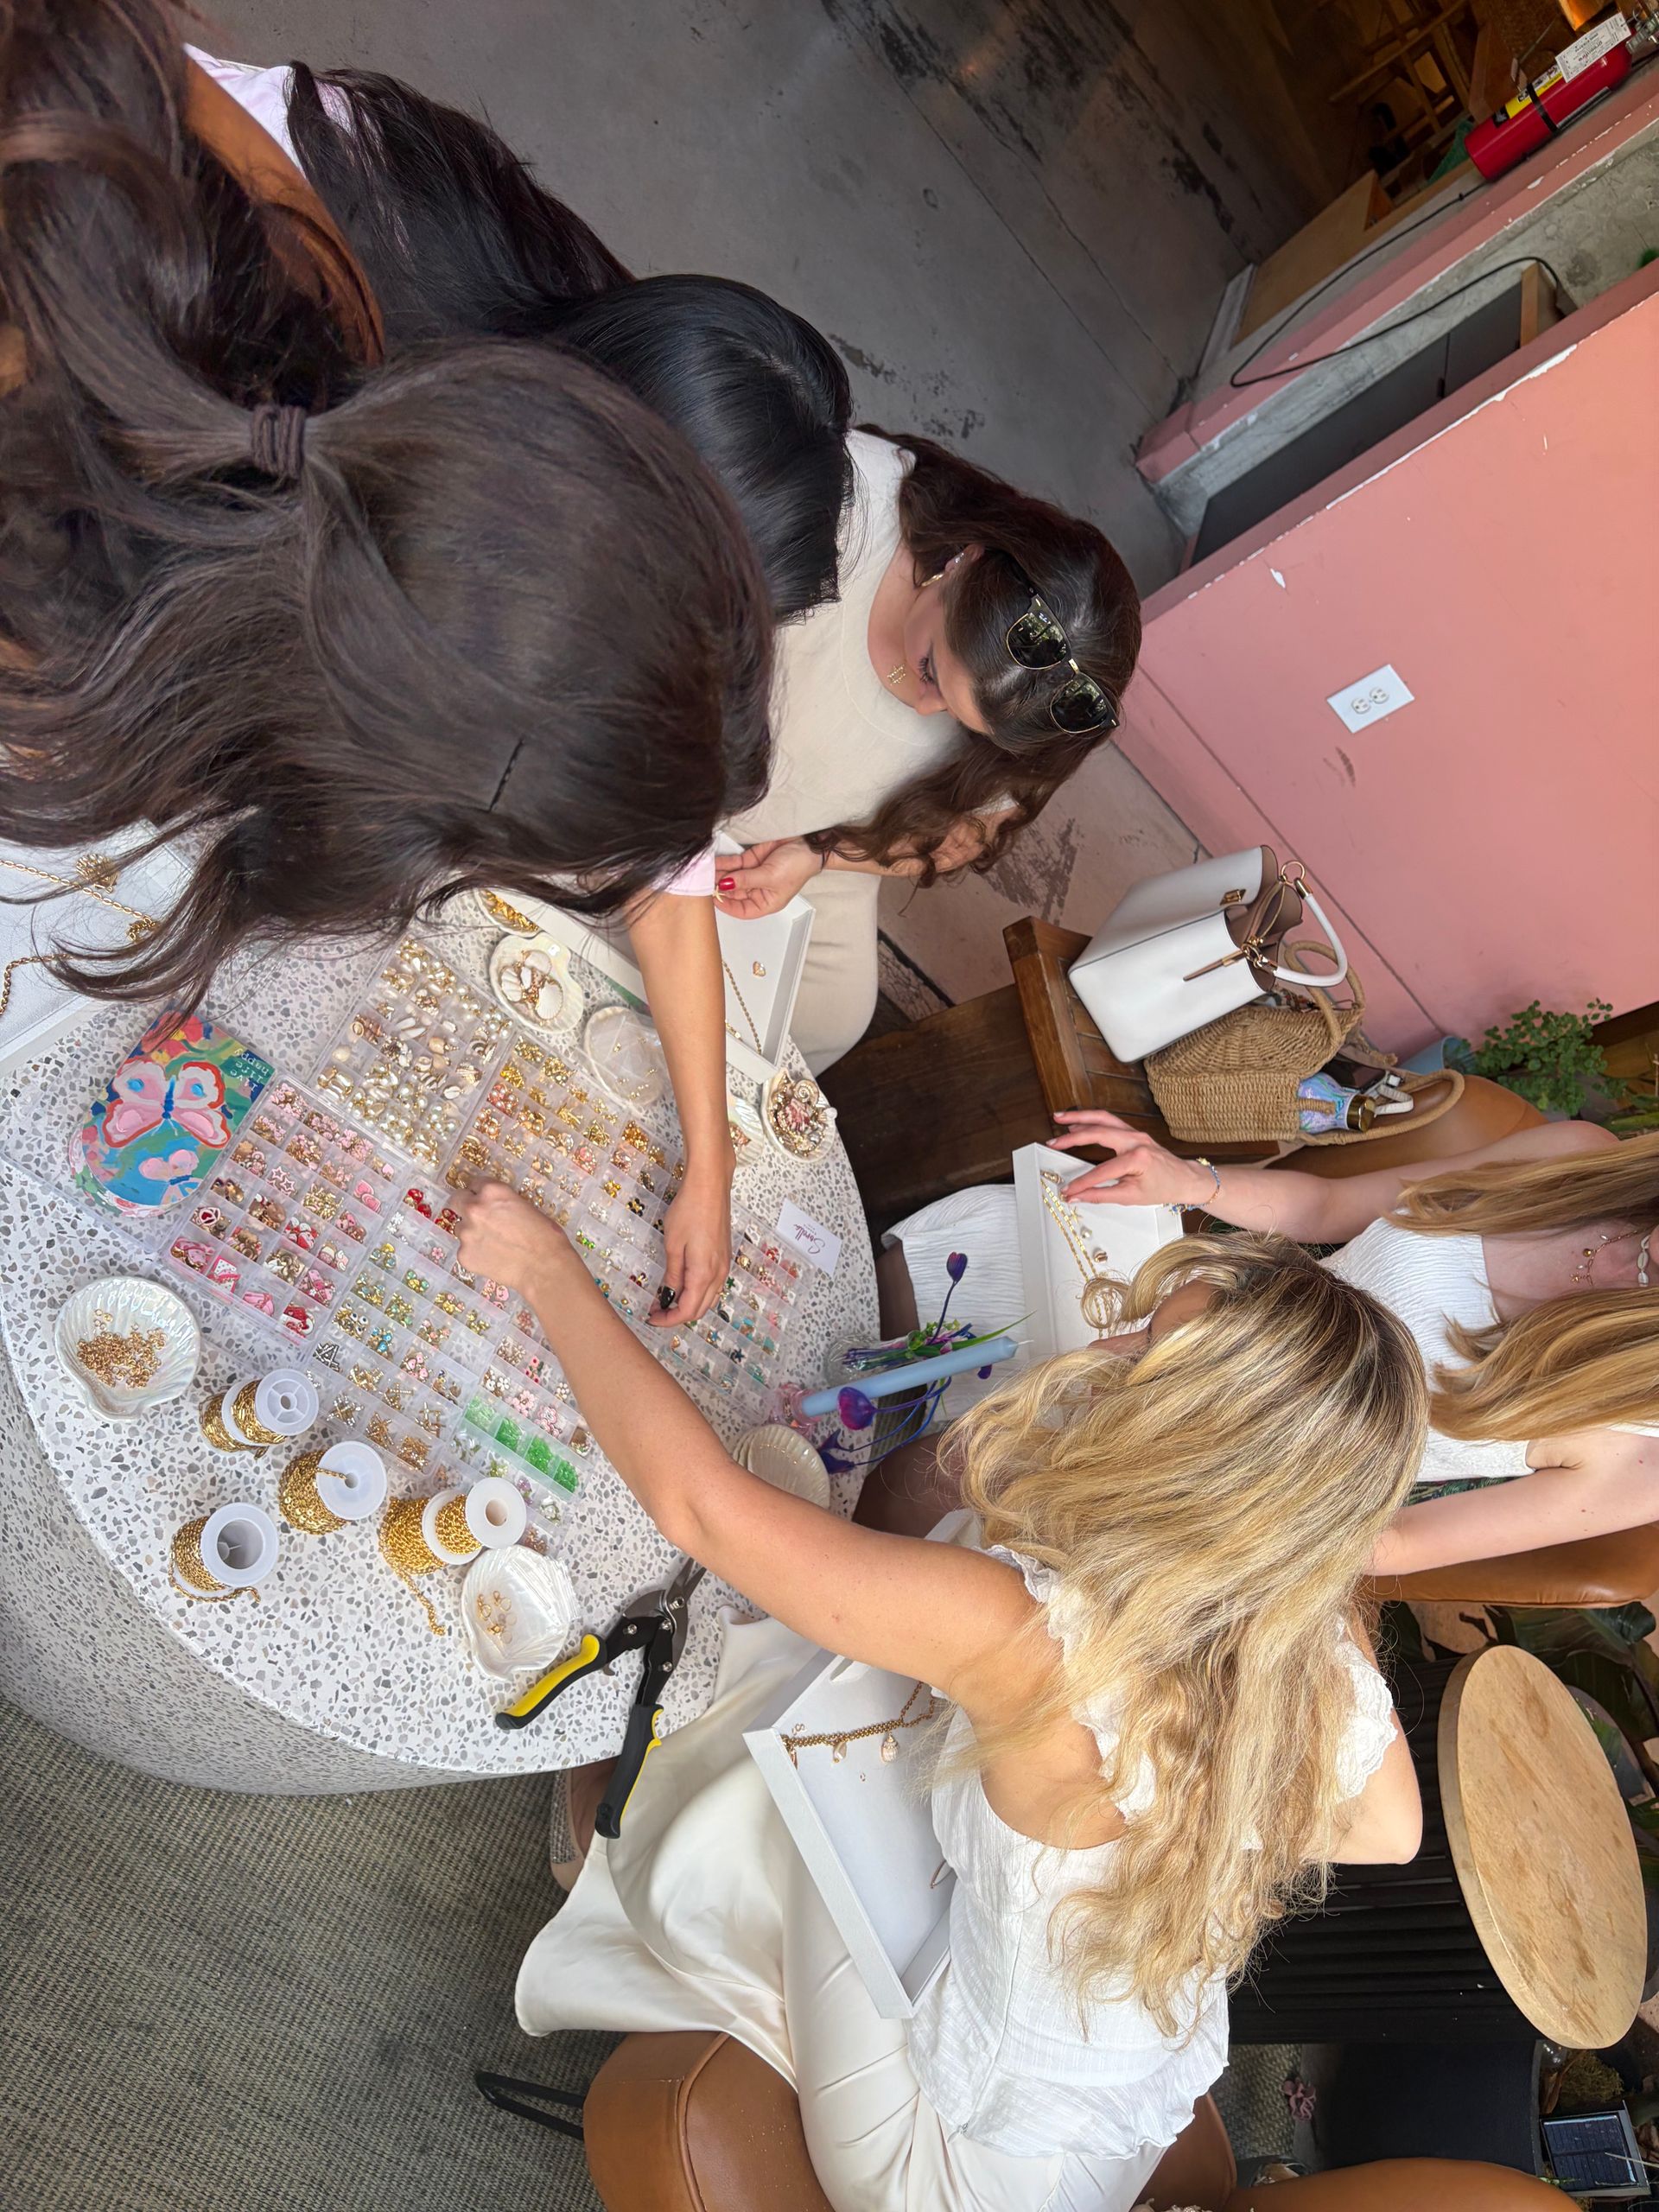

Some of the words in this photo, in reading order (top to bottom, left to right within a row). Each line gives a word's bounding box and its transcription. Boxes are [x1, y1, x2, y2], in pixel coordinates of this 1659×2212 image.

[234, 1048, 269, 1076] happy
[235, 1061, 264, 1084] life
[230, 1070, 258, 1092] live
